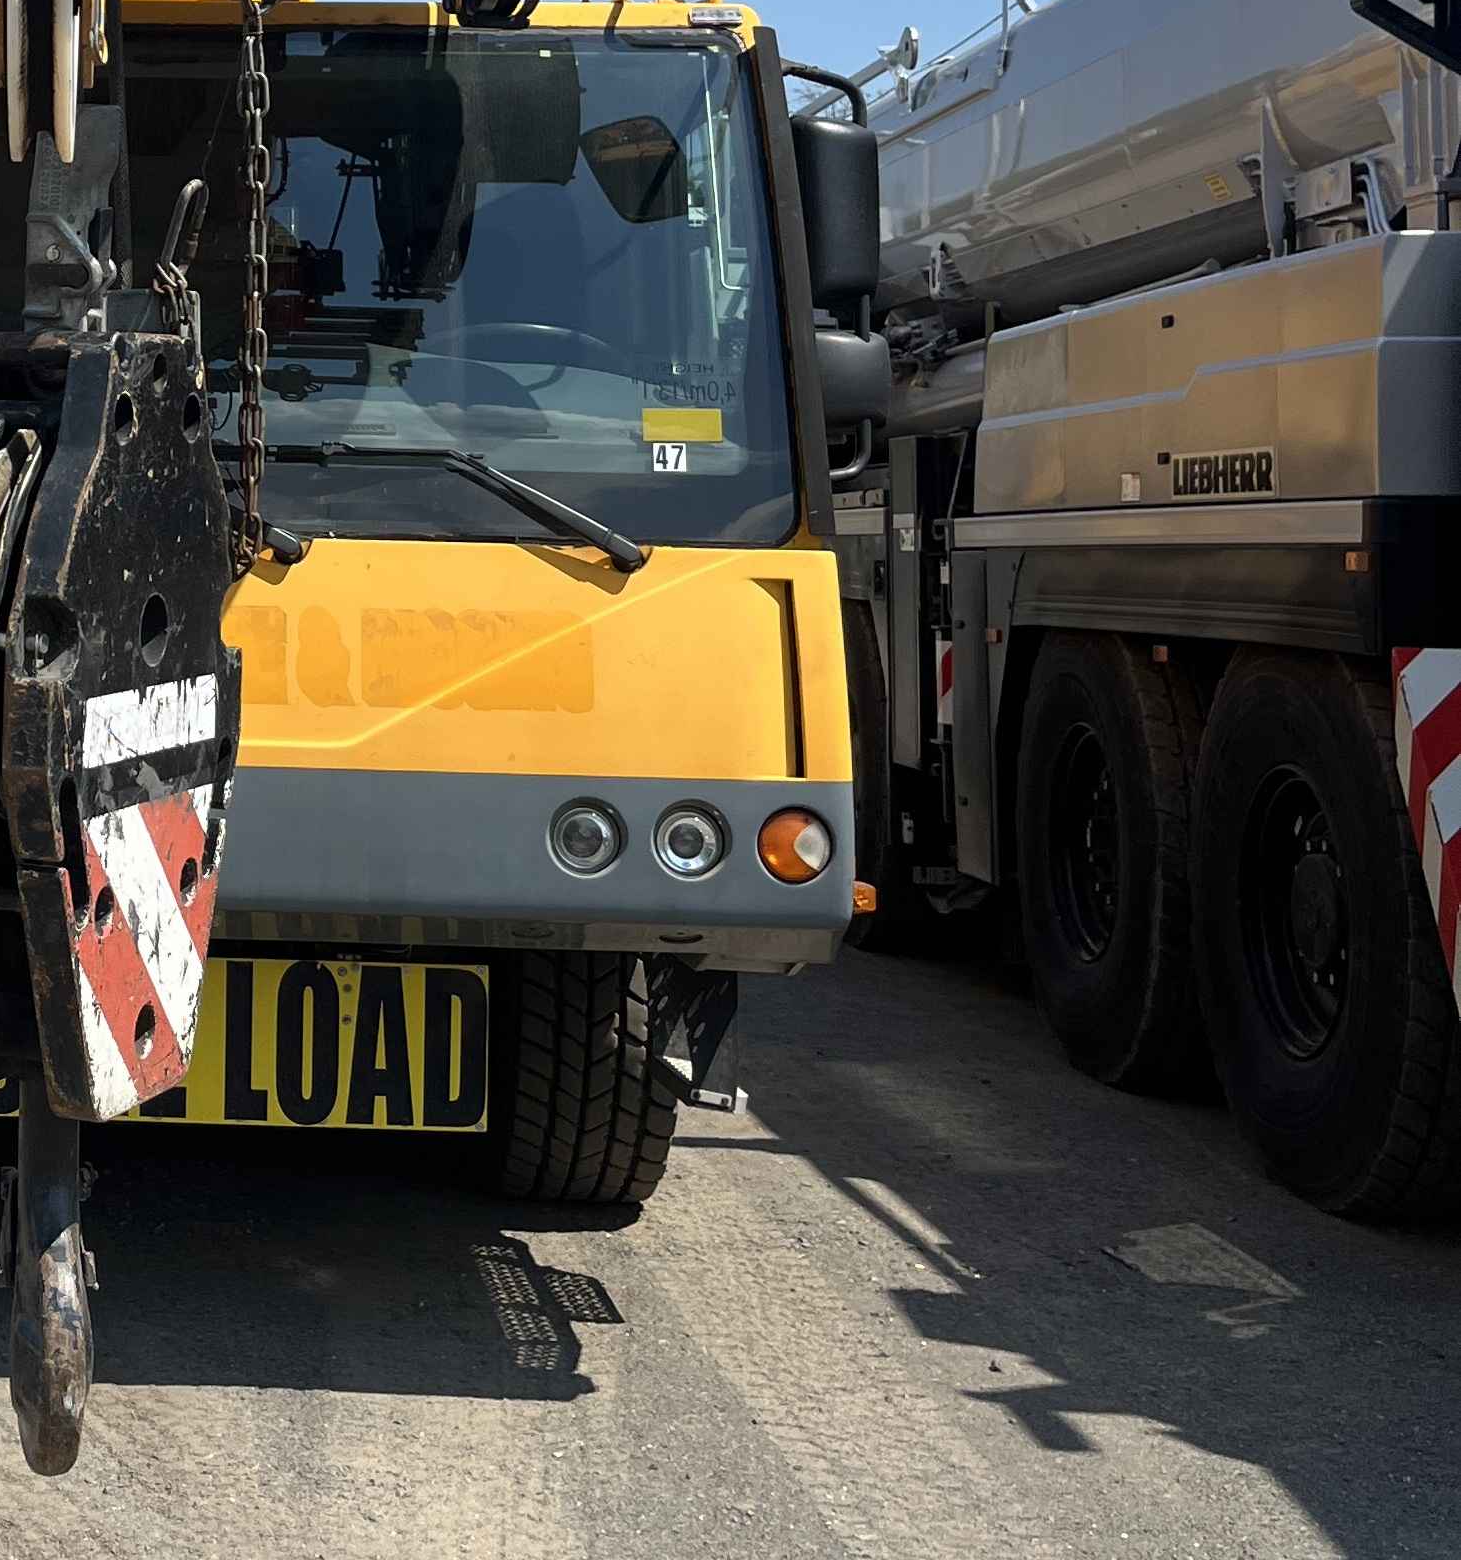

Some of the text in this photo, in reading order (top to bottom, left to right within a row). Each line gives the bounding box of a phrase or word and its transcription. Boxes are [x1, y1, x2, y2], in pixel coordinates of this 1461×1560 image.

[655, 444, 684, 470] 47
[1173, 452, 1272, 495] LIEBHERR
[223, 959, 488, 1127] LOAD
